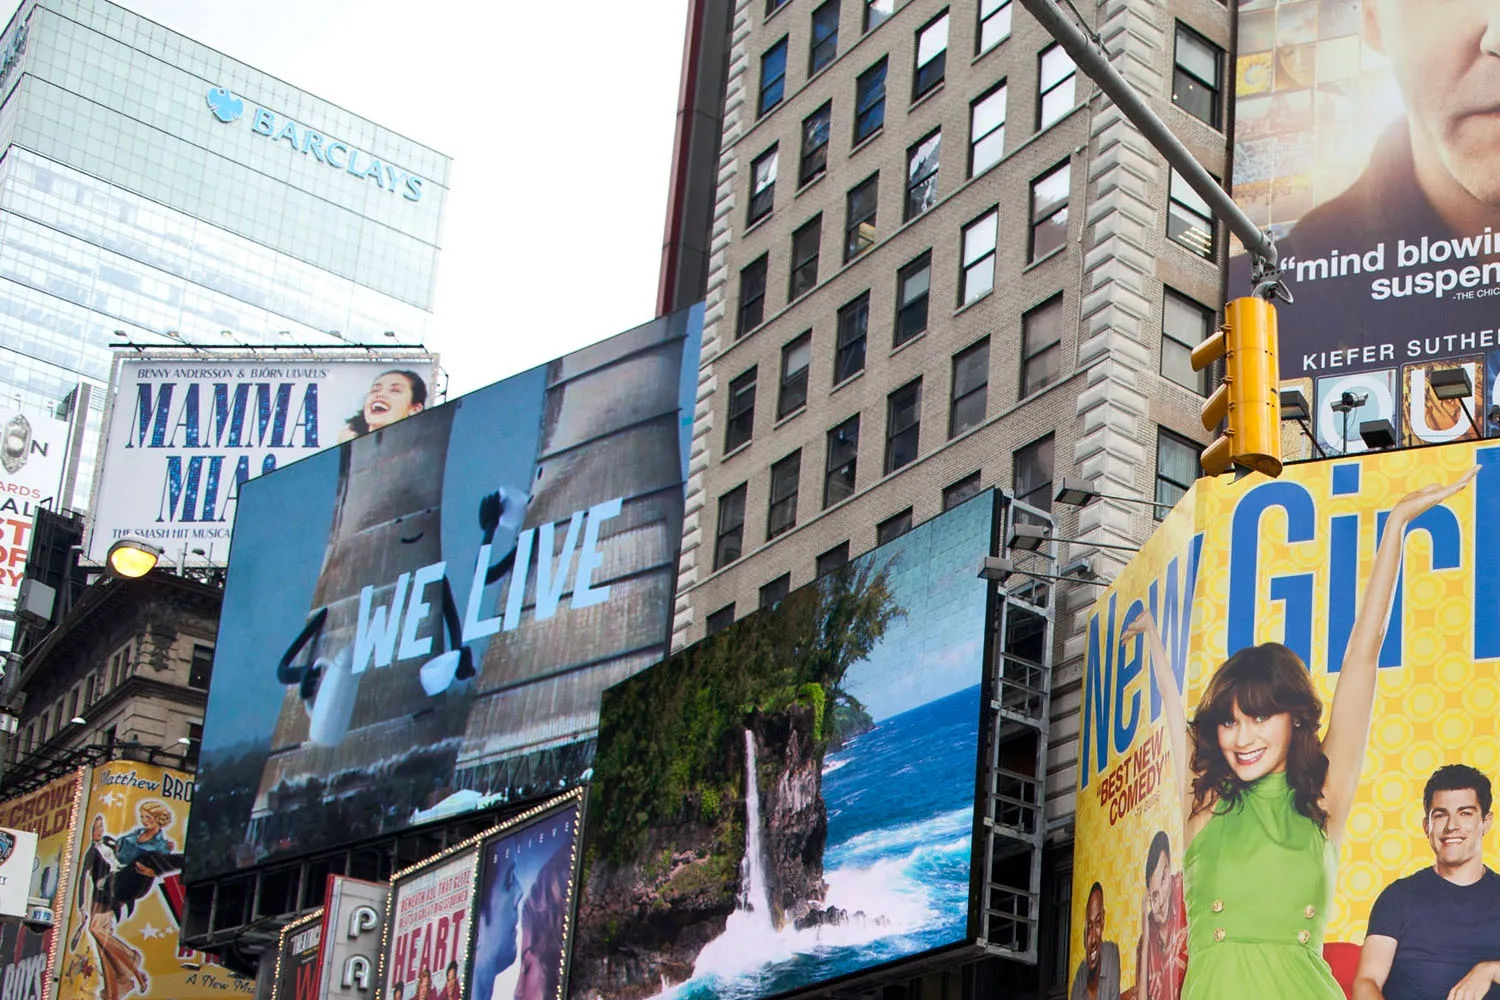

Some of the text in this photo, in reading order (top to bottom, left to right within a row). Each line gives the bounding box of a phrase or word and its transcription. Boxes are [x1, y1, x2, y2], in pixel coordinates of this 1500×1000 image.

[252, 106, 424, 202] BARCLAYS
[137, 368, 171, 379] BENNY
[172, 369, 234, 378] ANDERSSON
[236, 369, 245, 379] &
[1302, 343, 1396, 371] KIEFER
[125, 383, 320, 448] MAMMA
[134, 529, 170, 540] SMASH
[171, 529, 189, 540] HIT
[352, 497, 622, 674] WE LIVE
[1134, 727, 1164, 778] NEW
[391, 908, 466, 988] HEART
[201, 974, 229, 991] New
